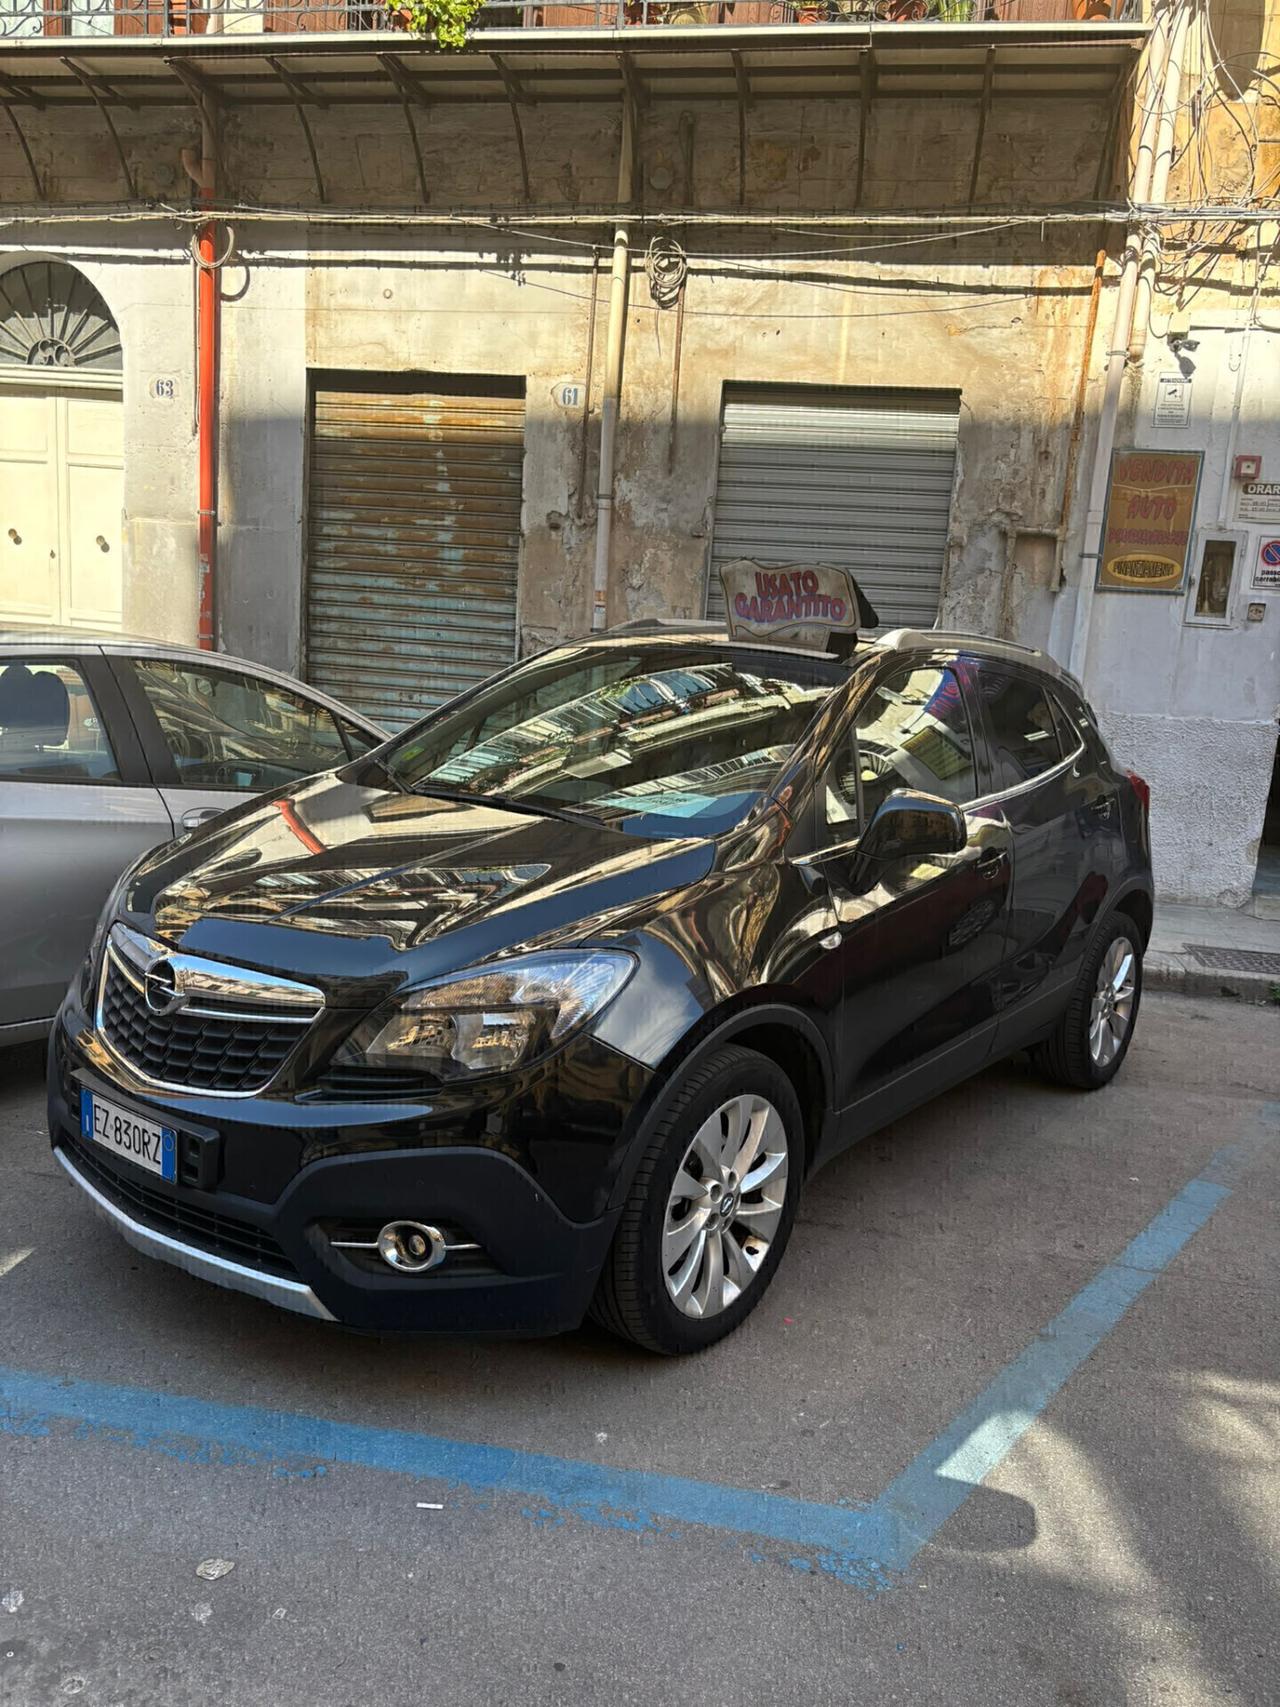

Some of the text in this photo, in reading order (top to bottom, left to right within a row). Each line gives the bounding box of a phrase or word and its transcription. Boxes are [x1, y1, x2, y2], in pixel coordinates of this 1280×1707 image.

[156, 379, 174, 398] 63
[562, 387, 579, 406] 61
[1118, 458, 1197, 485] VENDITA
[1126, 494, 1178, 521] AUTO
[754, 570, 819, 600] USATO
[734, 592, 847, 623] GARANTITO
